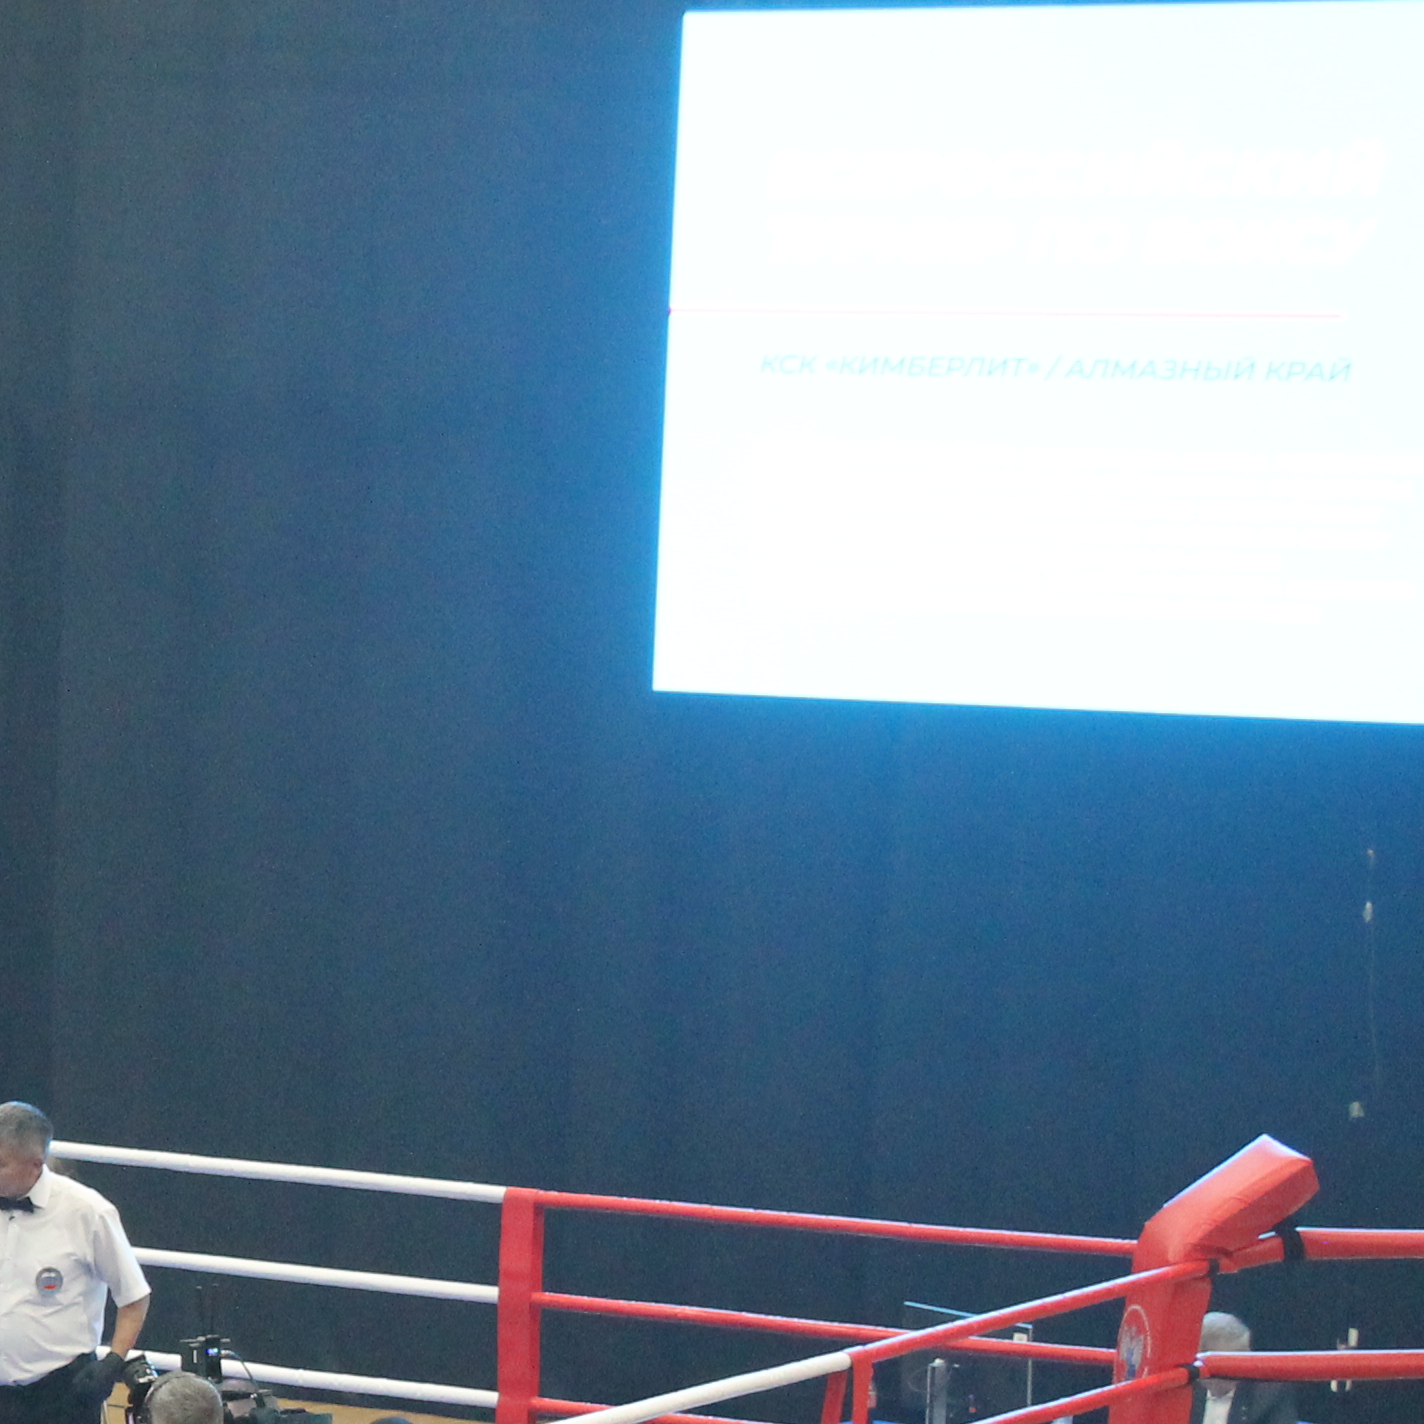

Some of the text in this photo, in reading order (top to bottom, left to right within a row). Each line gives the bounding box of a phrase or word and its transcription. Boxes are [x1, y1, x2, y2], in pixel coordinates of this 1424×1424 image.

[760, 354, 819, 375] КСК
[825, 355, 1040, 378] «КИМБЕРЛИТ»
[1064, 356, 1256, 382] АЛМАЗНЫЙ
[1264, 357, 1352, 383] КРАЙ
